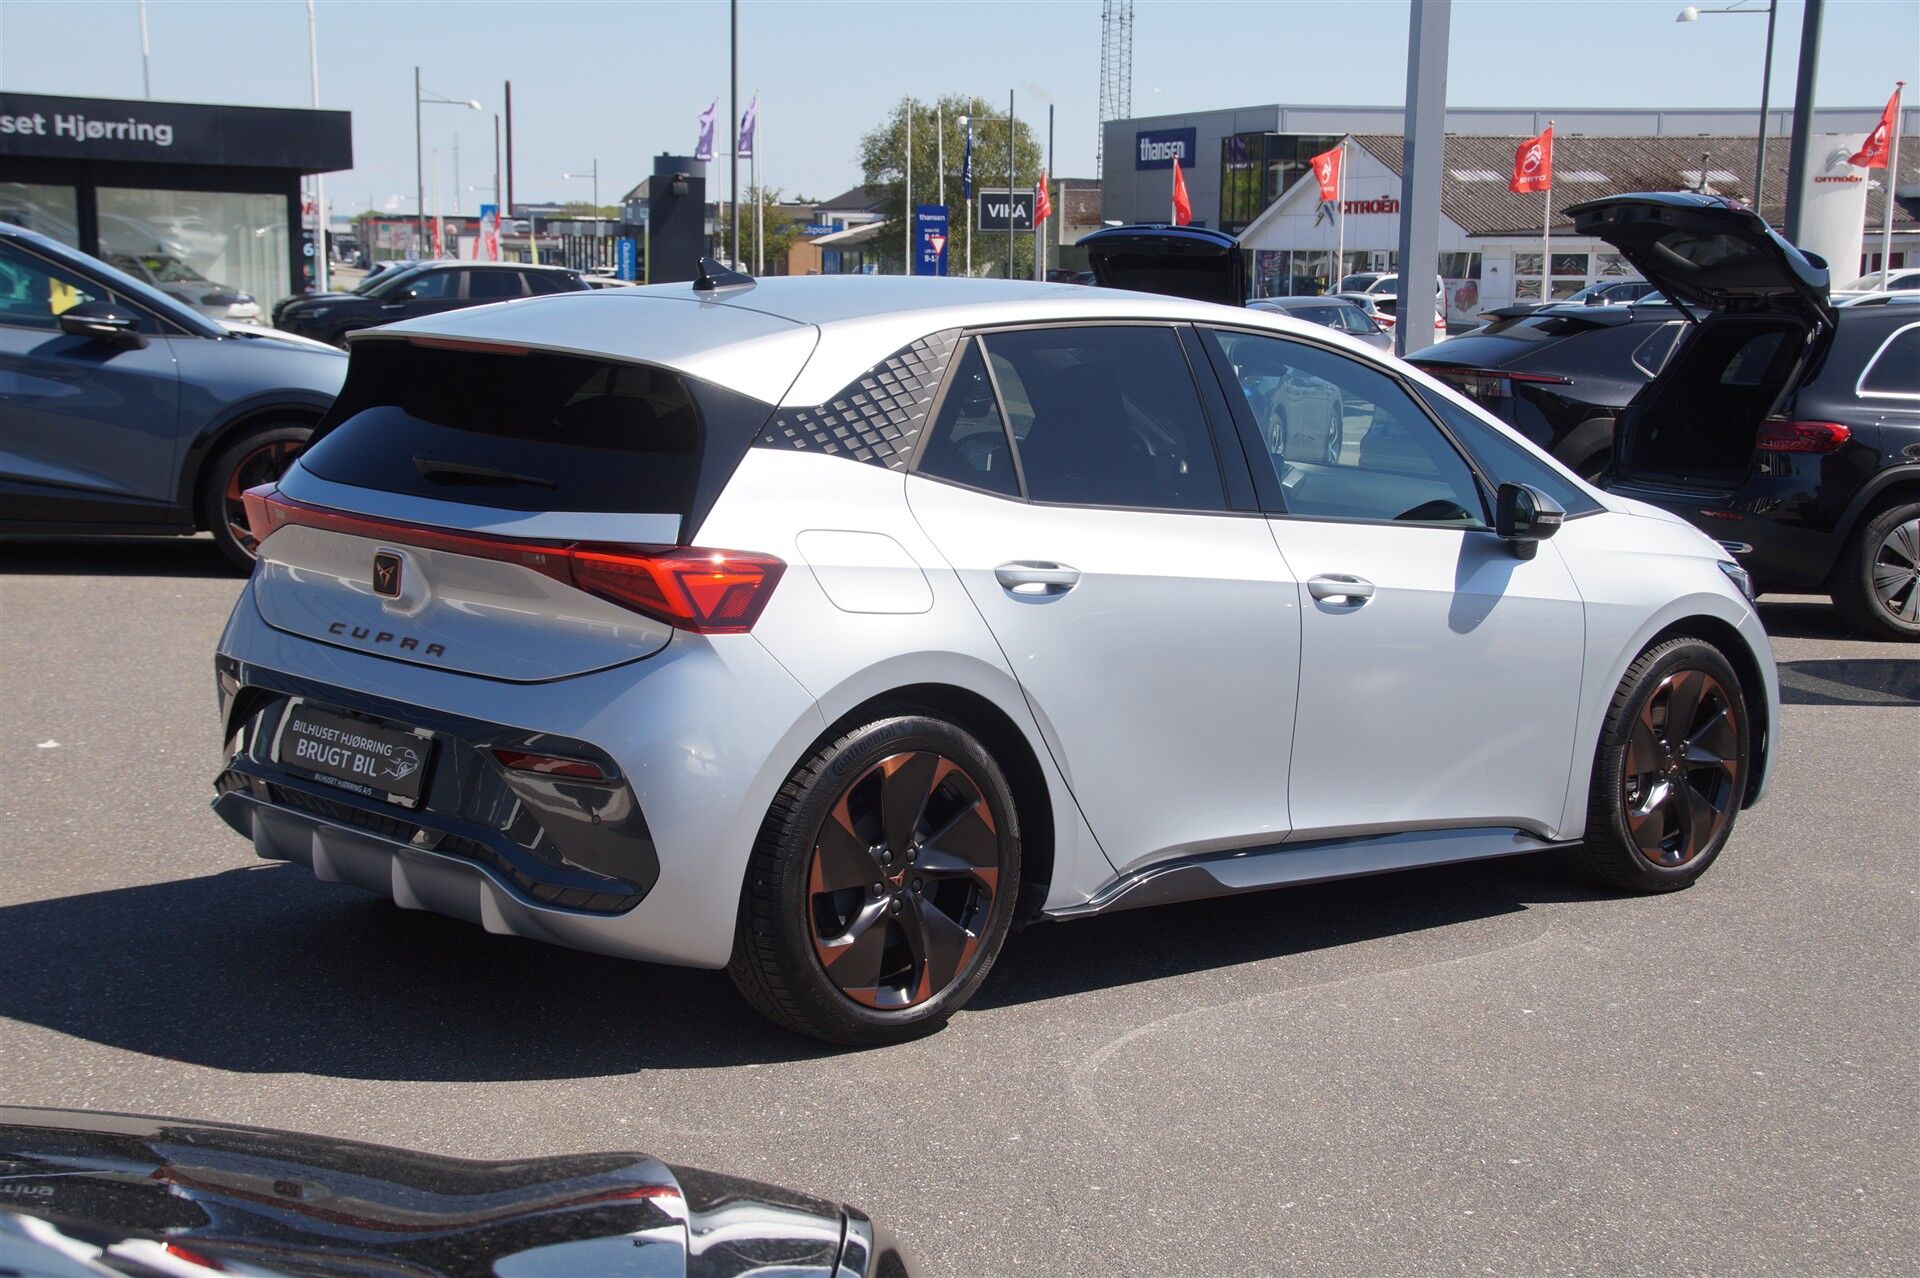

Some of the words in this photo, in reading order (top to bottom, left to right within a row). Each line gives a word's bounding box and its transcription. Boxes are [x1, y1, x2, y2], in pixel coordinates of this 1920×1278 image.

[0, 113, 46, 135] set
[54, 113, 173, 146] Hjørring
[1140, 138, 1185, 160] thansen
[919, 213, 946, 221] thansen
[987, 203, 1026, 217] VIKA
[622, 242, 631, 280] Quickpoin
[328, 622, 446, 657] CUPRA
[292, 719, 340, 742] BILHUSET
[341, 732, 393, 756] HJØRRING
[296, 738, 352, 768] BRUGT
[352, 753, 377, 777] BIL
[314, 772, 338, 787] BILHUSET
[362, 787, 372, 796] A/S
